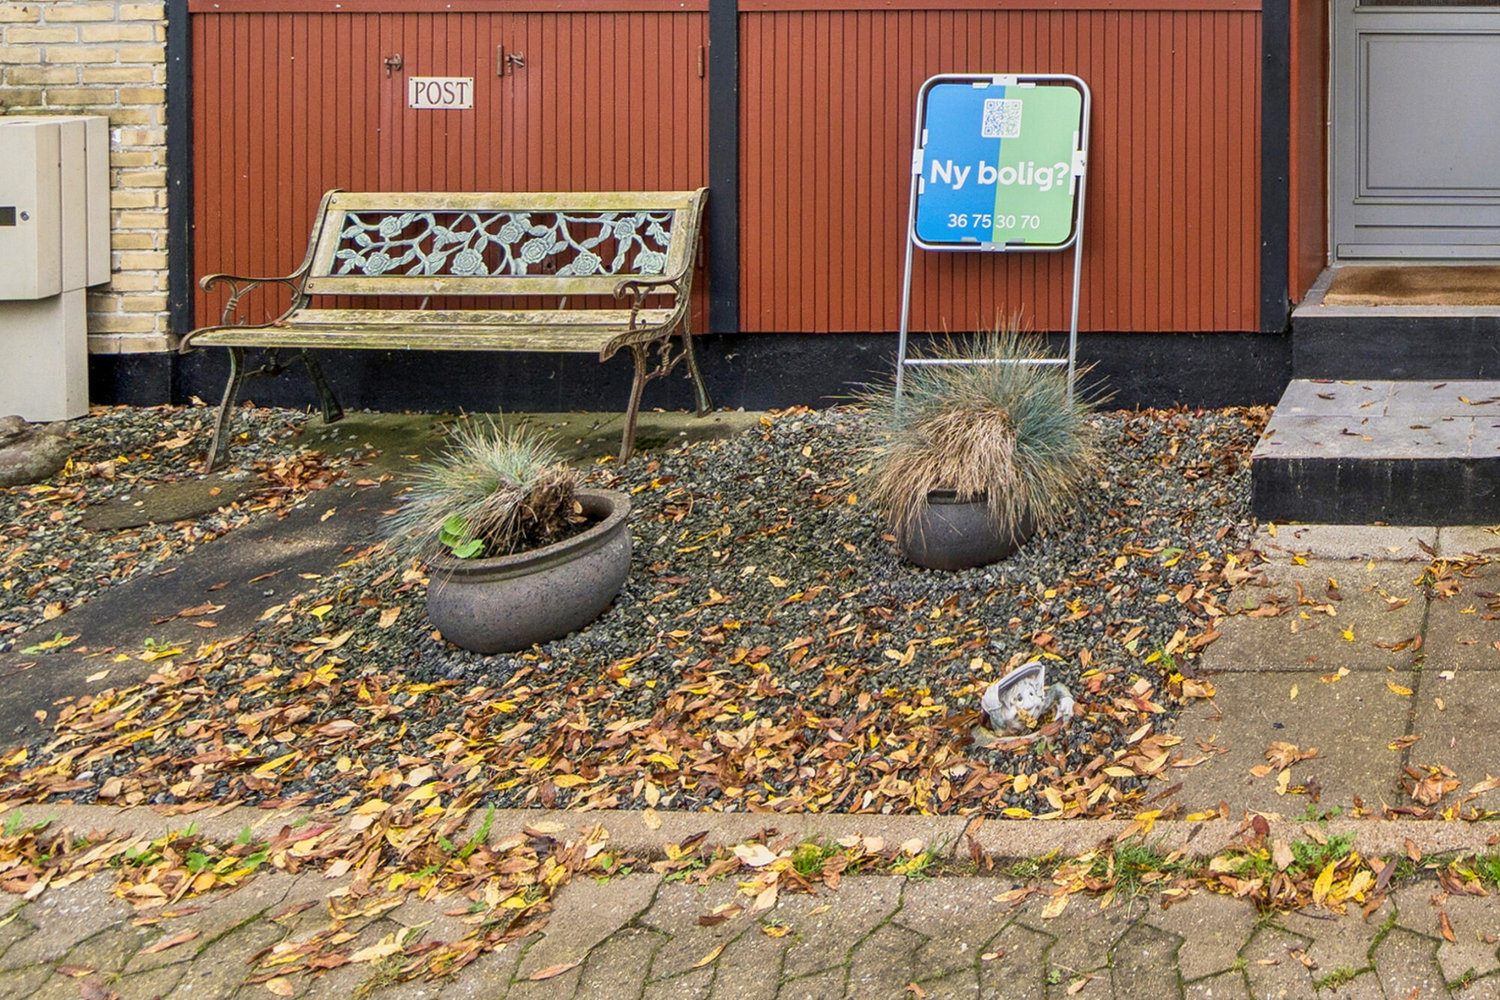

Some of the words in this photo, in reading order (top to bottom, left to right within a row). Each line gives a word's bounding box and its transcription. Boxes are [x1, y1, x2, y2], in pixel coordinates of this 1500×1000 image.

[414, 81, 469, 105] POST
[930, 159, 971, 190] Ny
[977, 160, 1069, 192] bolig?
[947, 213, 968, 228] 36
[972, 214, 992, 229] 75
[995, 214, 1016, 229] 30
[1020, 215, 1041, 229] 70
